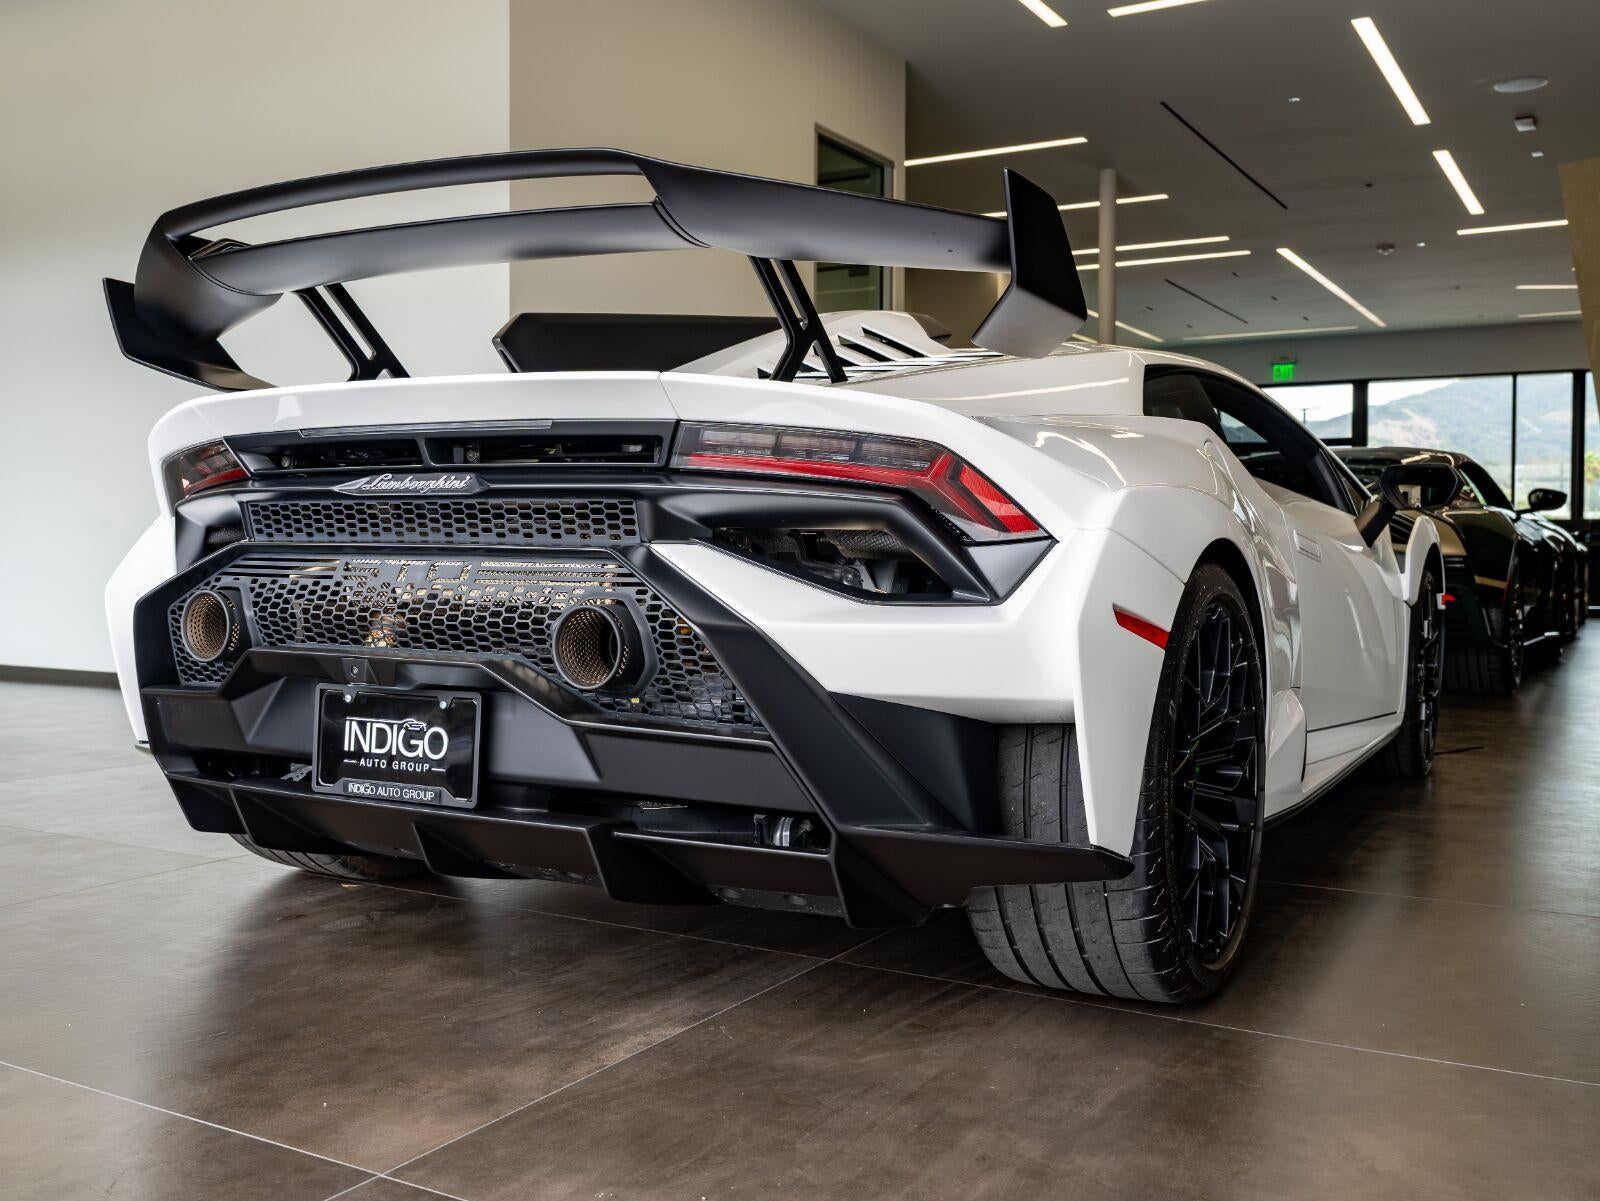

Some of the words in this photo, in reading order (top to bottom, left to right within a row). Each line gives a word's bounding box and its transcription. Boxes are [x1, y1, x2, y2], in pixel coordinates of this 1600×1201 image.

[362, 473, 471, 494] Lamborghini
[343, 720, 449, 760] INDIGO
[359, 759, 387, 769] AUTO
[392, 761, 430, 772] GROUP
[348, 783, 375, 795] INDIGO
[376, 786, 401, 798] AUTO
[402, 789, 435, 801] GROUP
